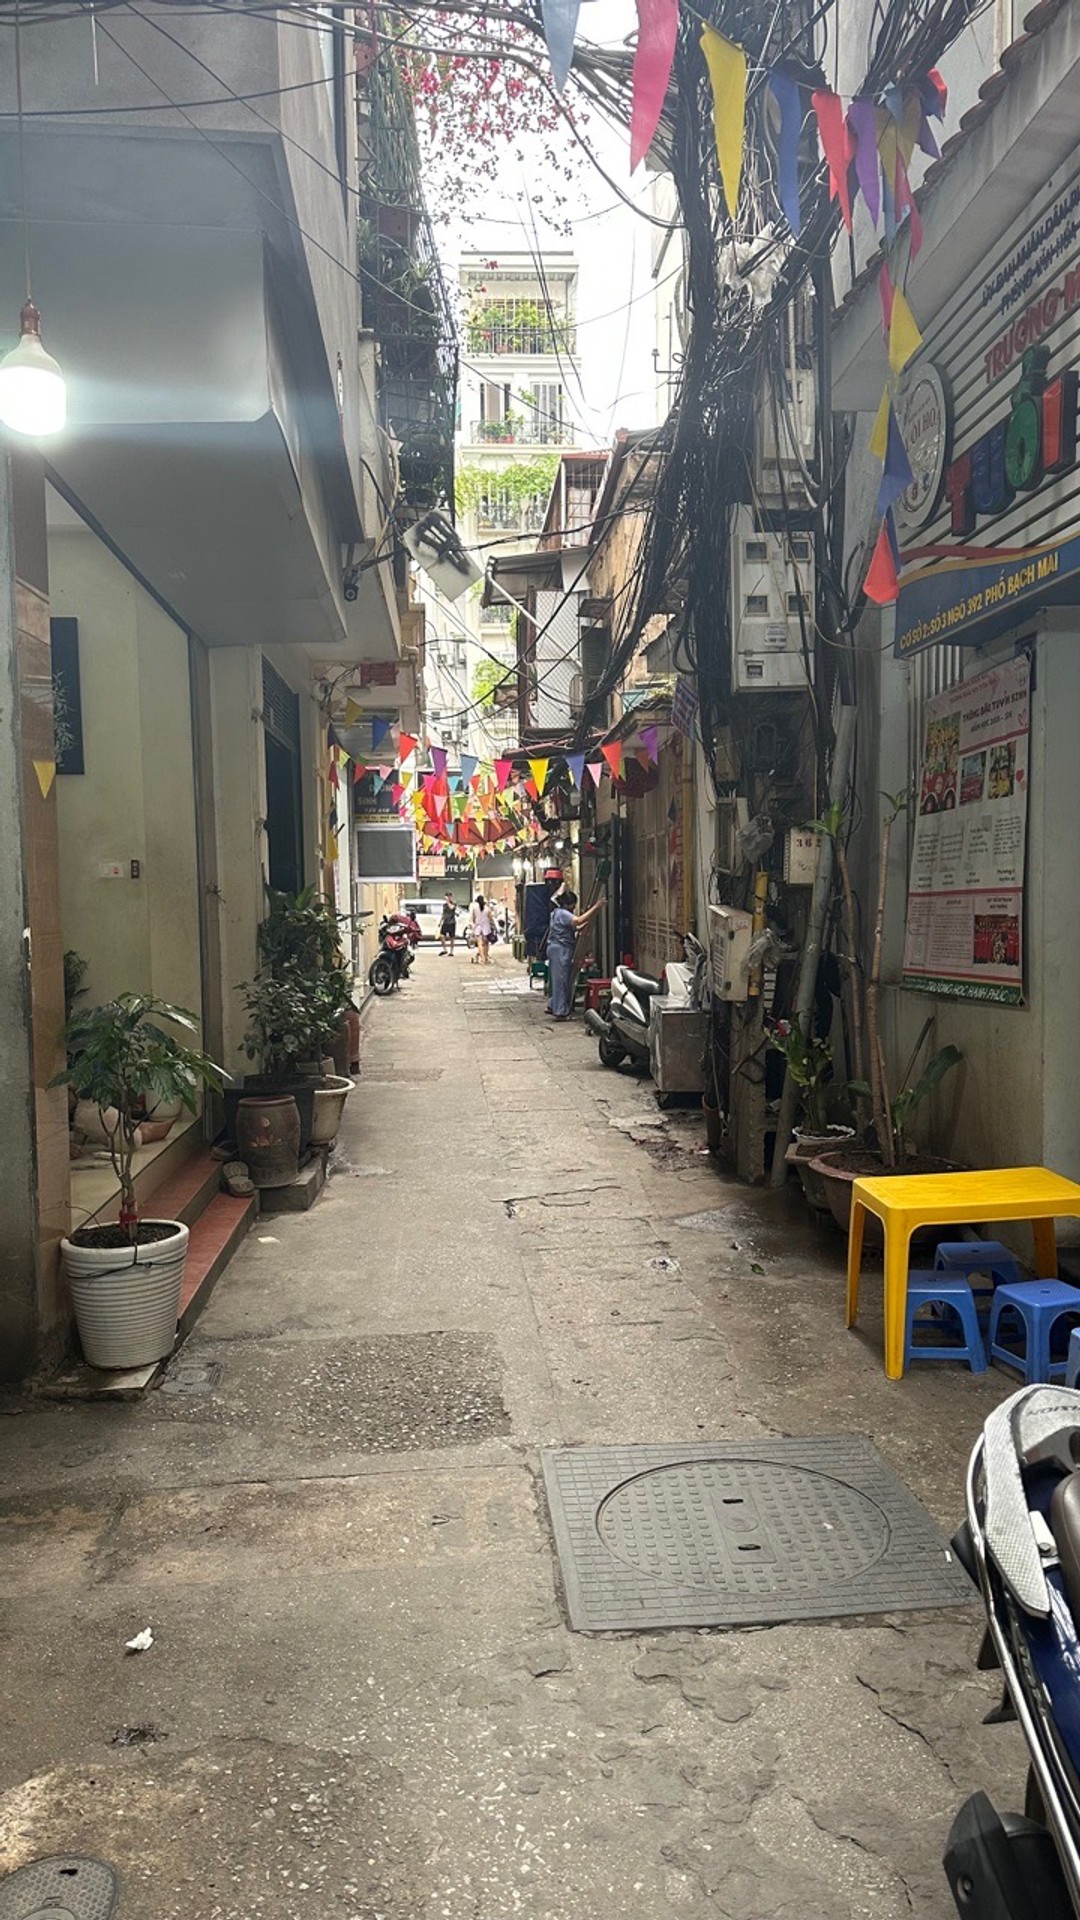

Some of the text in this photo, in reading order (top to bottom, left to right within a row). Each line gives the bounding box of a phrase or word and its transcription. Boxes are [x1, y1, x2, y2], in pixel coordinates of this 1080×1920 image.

[967, 593, 983, 615] 392
[985, 568, 1006, 607] PHỐ
[1007, 563, 1035, 596] BẠCH
[1037, 552, 1059, 580] MAI
[987, 985, 1008, 1001] PHÚC
